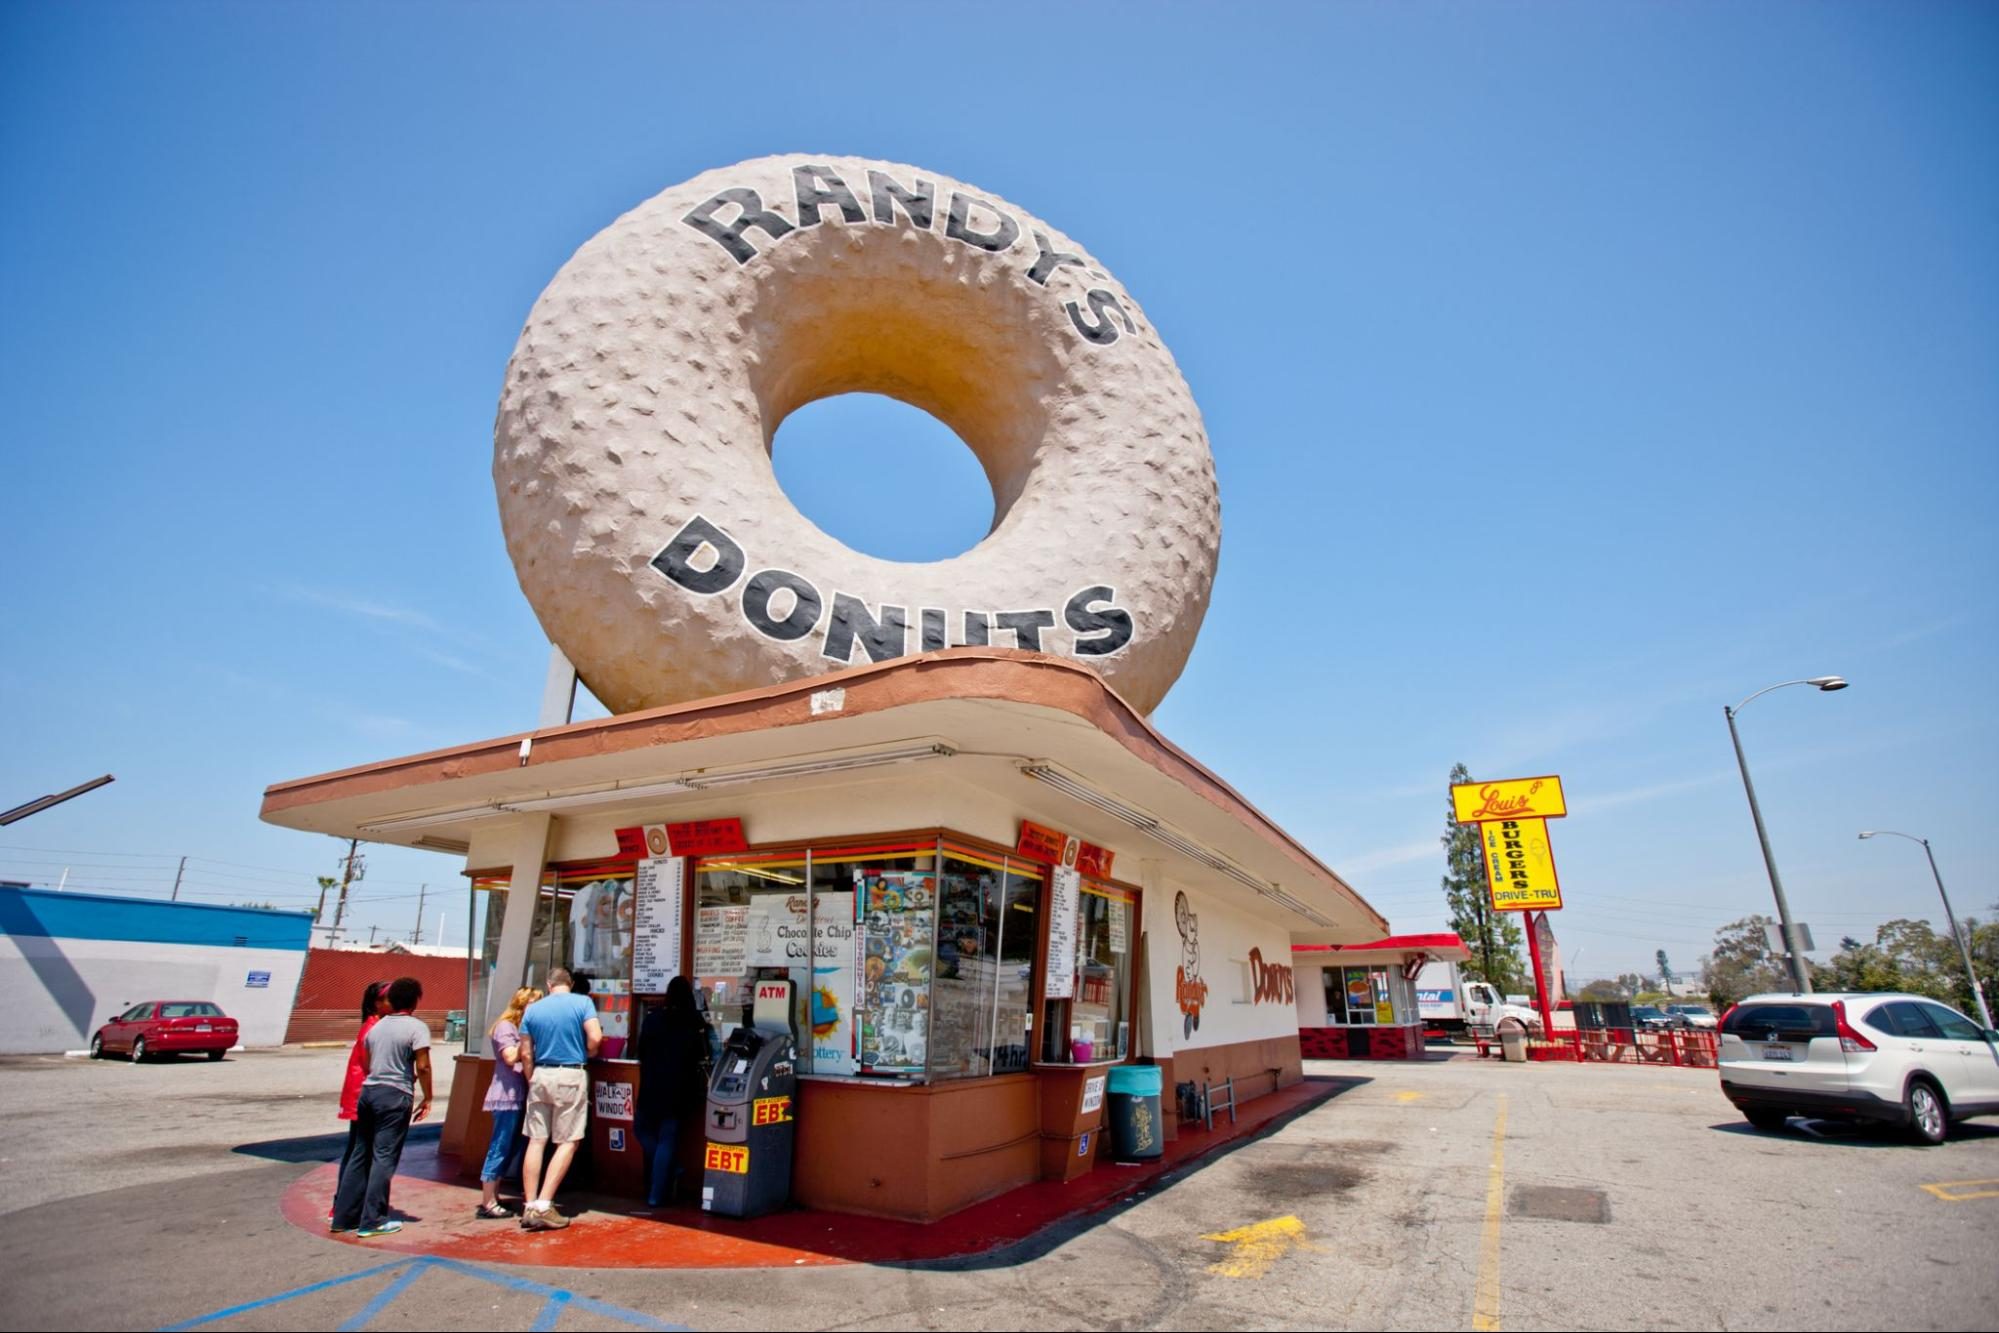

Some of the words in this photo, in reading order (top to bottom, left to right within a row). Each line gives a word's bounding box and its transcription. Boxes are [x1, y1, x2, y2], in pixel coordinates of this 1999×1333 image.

[680, 164, 1137, 346] RANDY'S
[648, 513, 1134, 663] DONUTS
[1501, 821, 1529, 889] BURGERS
[777, 925, 823, 938] Chocote
[827, 925, 851, 940] Chip
[786, 940, 838, 958] Cooies
[759, 986, 786, 999] ATM
[598, 1101, 625, 1116] WINDO
[707, 1149, 744, 1171] EBT
